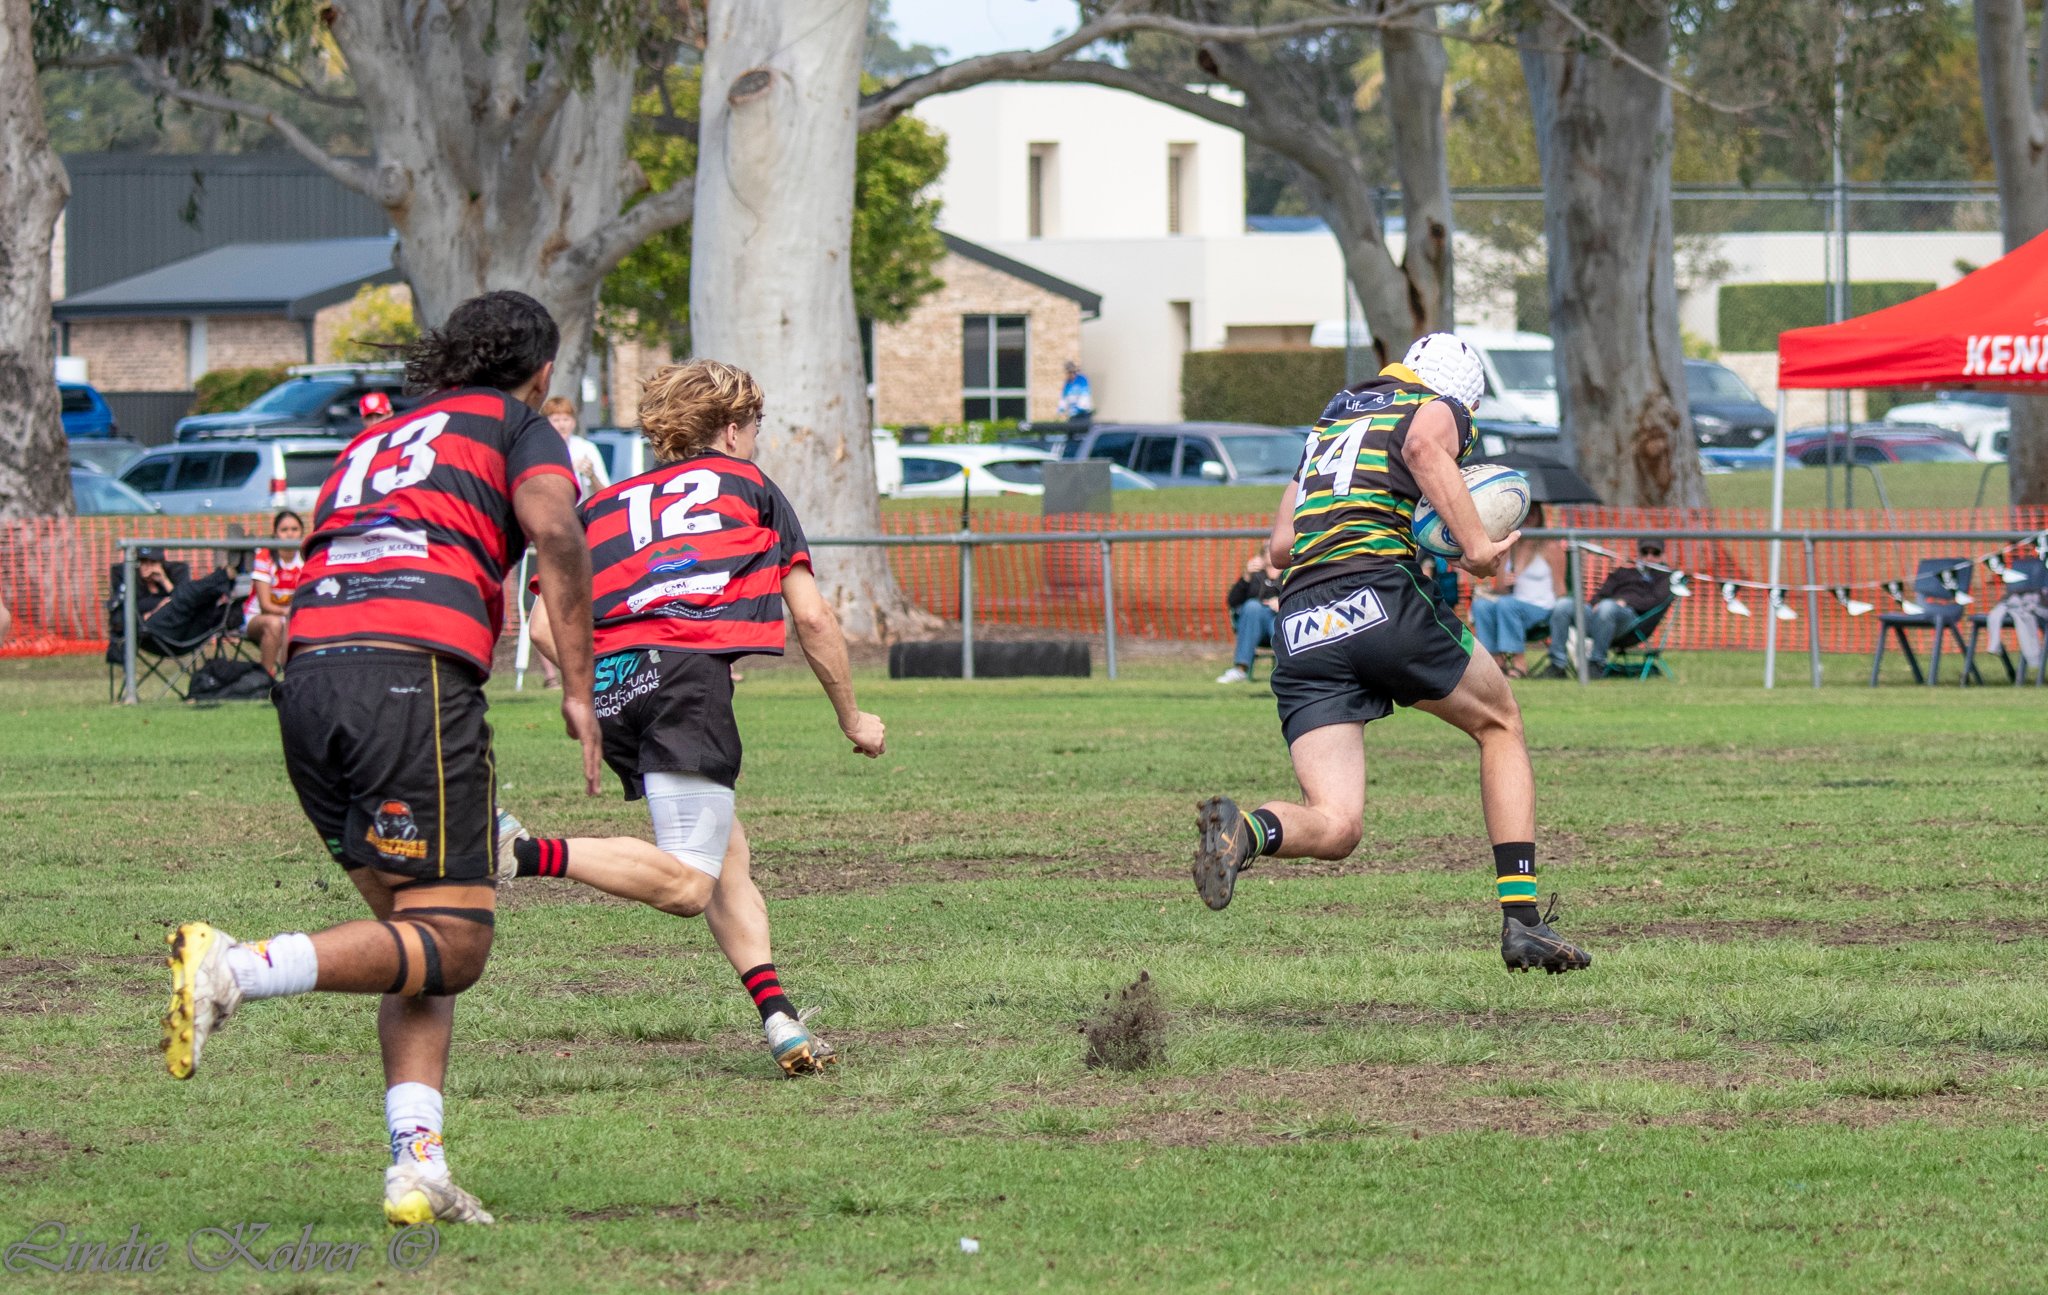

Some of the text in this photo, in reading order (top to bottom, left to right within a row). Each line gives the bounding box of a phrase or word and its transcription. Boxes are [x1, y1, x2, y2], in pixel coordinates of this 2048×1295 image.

[334, 411, 450, 508] 13
[1295, 417, 1373, 509] 14
[618, 468, 722, 551] 12
